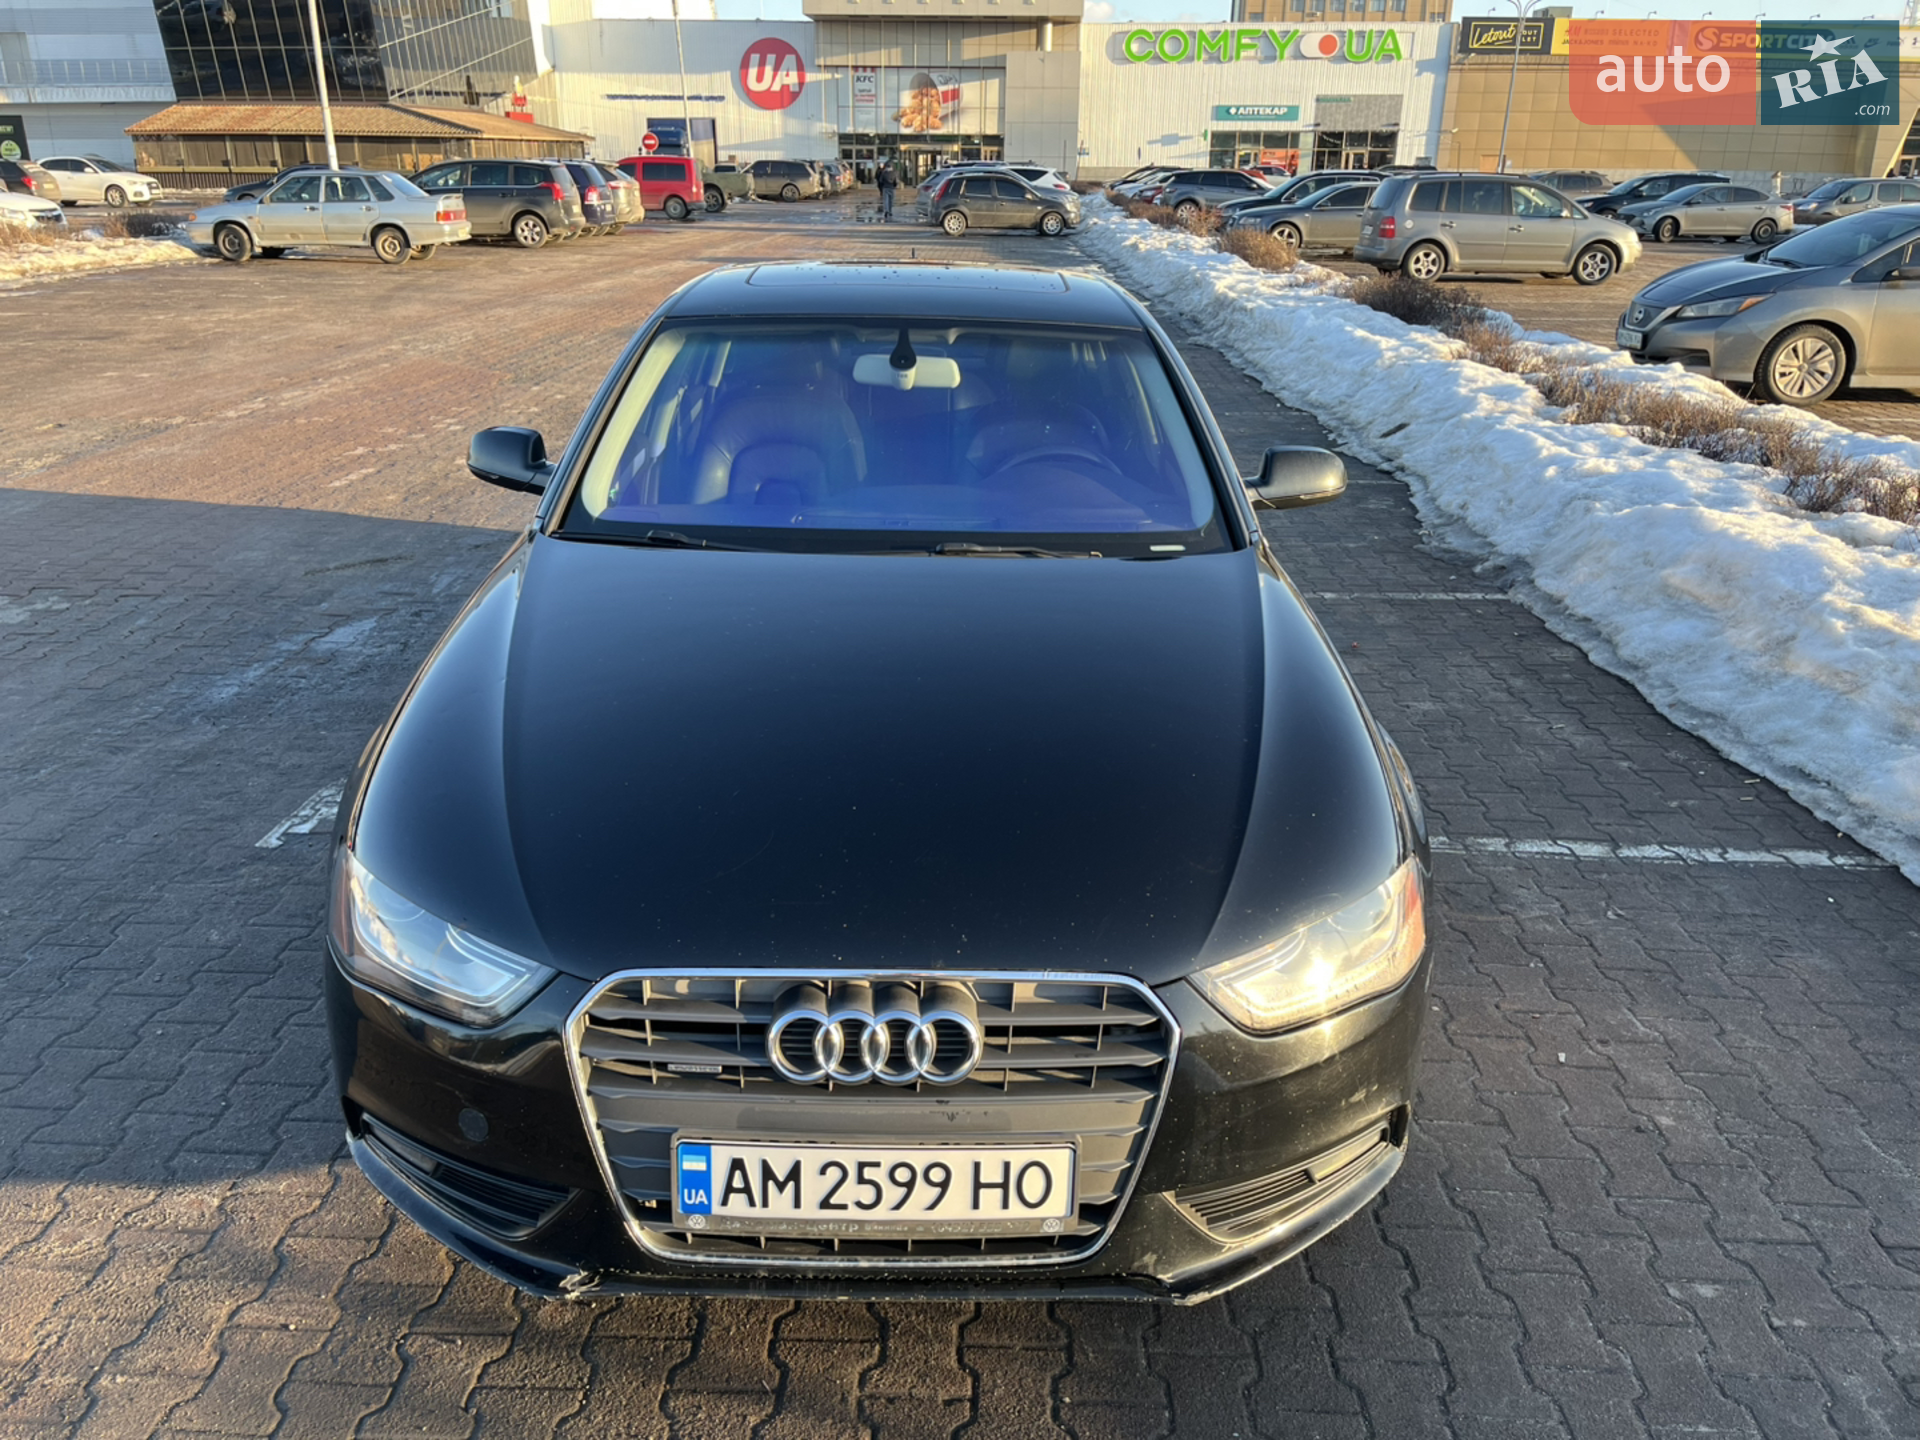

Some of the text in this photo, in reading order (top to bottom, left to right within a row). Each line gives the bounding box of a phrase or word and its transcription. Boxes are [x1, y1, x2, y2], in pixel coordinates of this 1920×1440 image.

[1473, 24, 1516, 47] Letout
[1612, 28, 1659, 37] SELECTED
[1124, 29, 1403, 62] COMFY UA
[746, 53, 800, 93] UA
[855, 75, 874, 83] KFC
[1237, 106, 1288, 116] АПТЕКАР
[720, 1157, 1054, 1211] AM 2599 HO
[683, 1188, 709, 1204] UA
